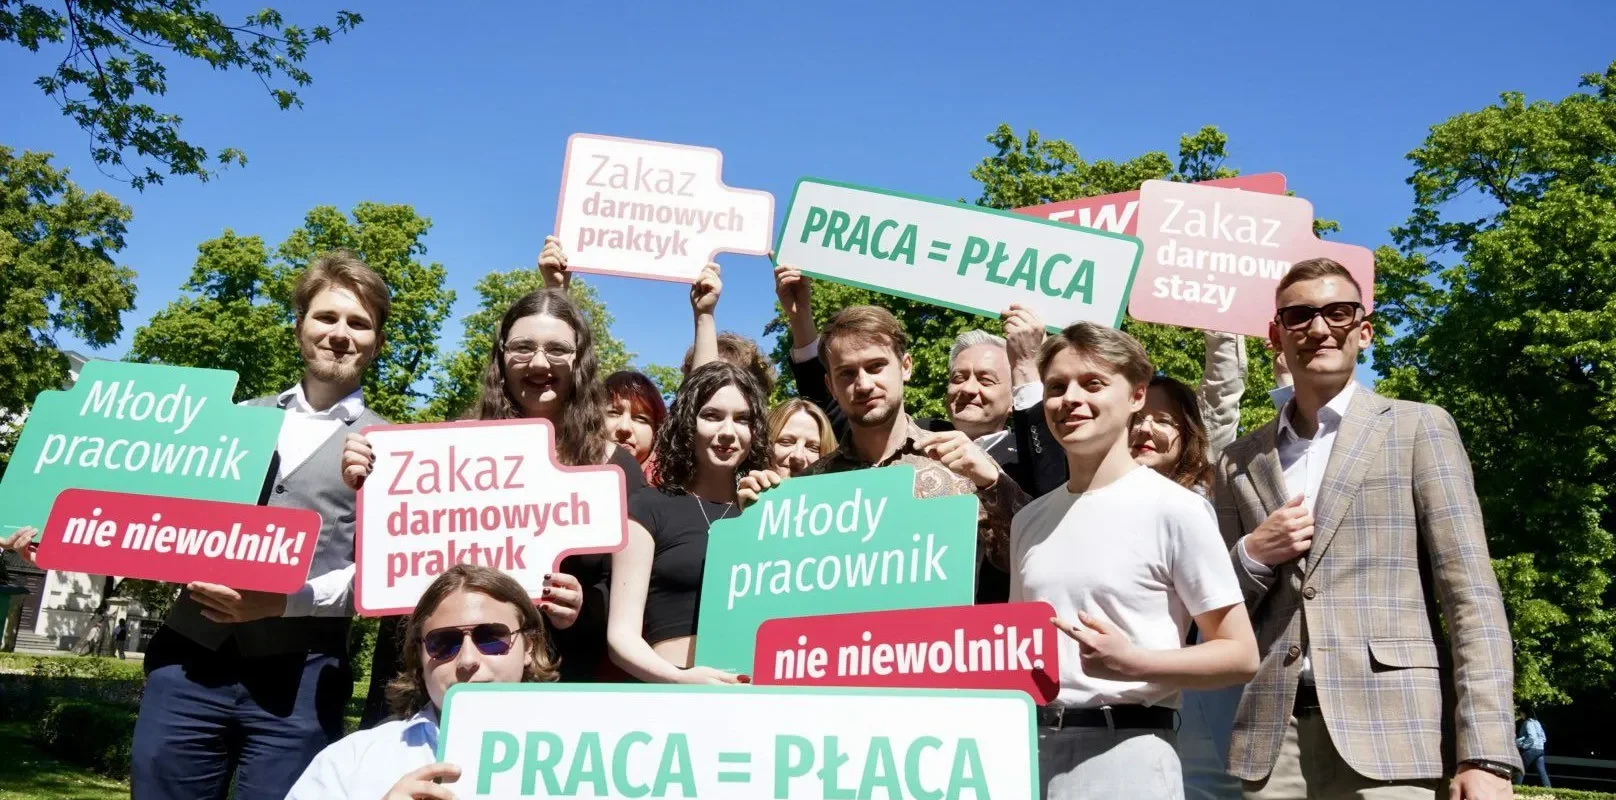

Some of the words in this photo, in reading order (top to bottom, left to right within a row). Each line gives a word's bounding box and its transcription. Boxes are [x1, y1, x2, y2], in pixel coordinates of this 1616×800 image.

[586, 154, 697, 197] Zakaz
[582, 191, 744, 234] darmowych
[1159, 198, 1282, 248] Zakaz
[577, 225, 689, 260] praktyk
[799, 205, 919, 265] PRACA
[927, 240, 952, 262] =
[956, 235, 1096, 305] PŁACA
[1152, 273, 1237, 313] staży
[79, 380, 207, 434] Młody
[33, 433, 249, 480] pracownik
[387, 445, 525, 496] Zakaz
[62, 507, 117, 547] nie
[121, 512, 306, 566] niewolnik!
[386, 492, 591, 537] darmowych
[757, 488, 888, 543] Młody
[727, 533, 949, 610] pracownik
[774, 635, 828, 680] nie
[837, 624, 1046, 677] niewolnik!
[476, 730, 698, 799] PRACA
[717, 752, 752, 783] =
[774, 734, 991, 800] PŁACA
